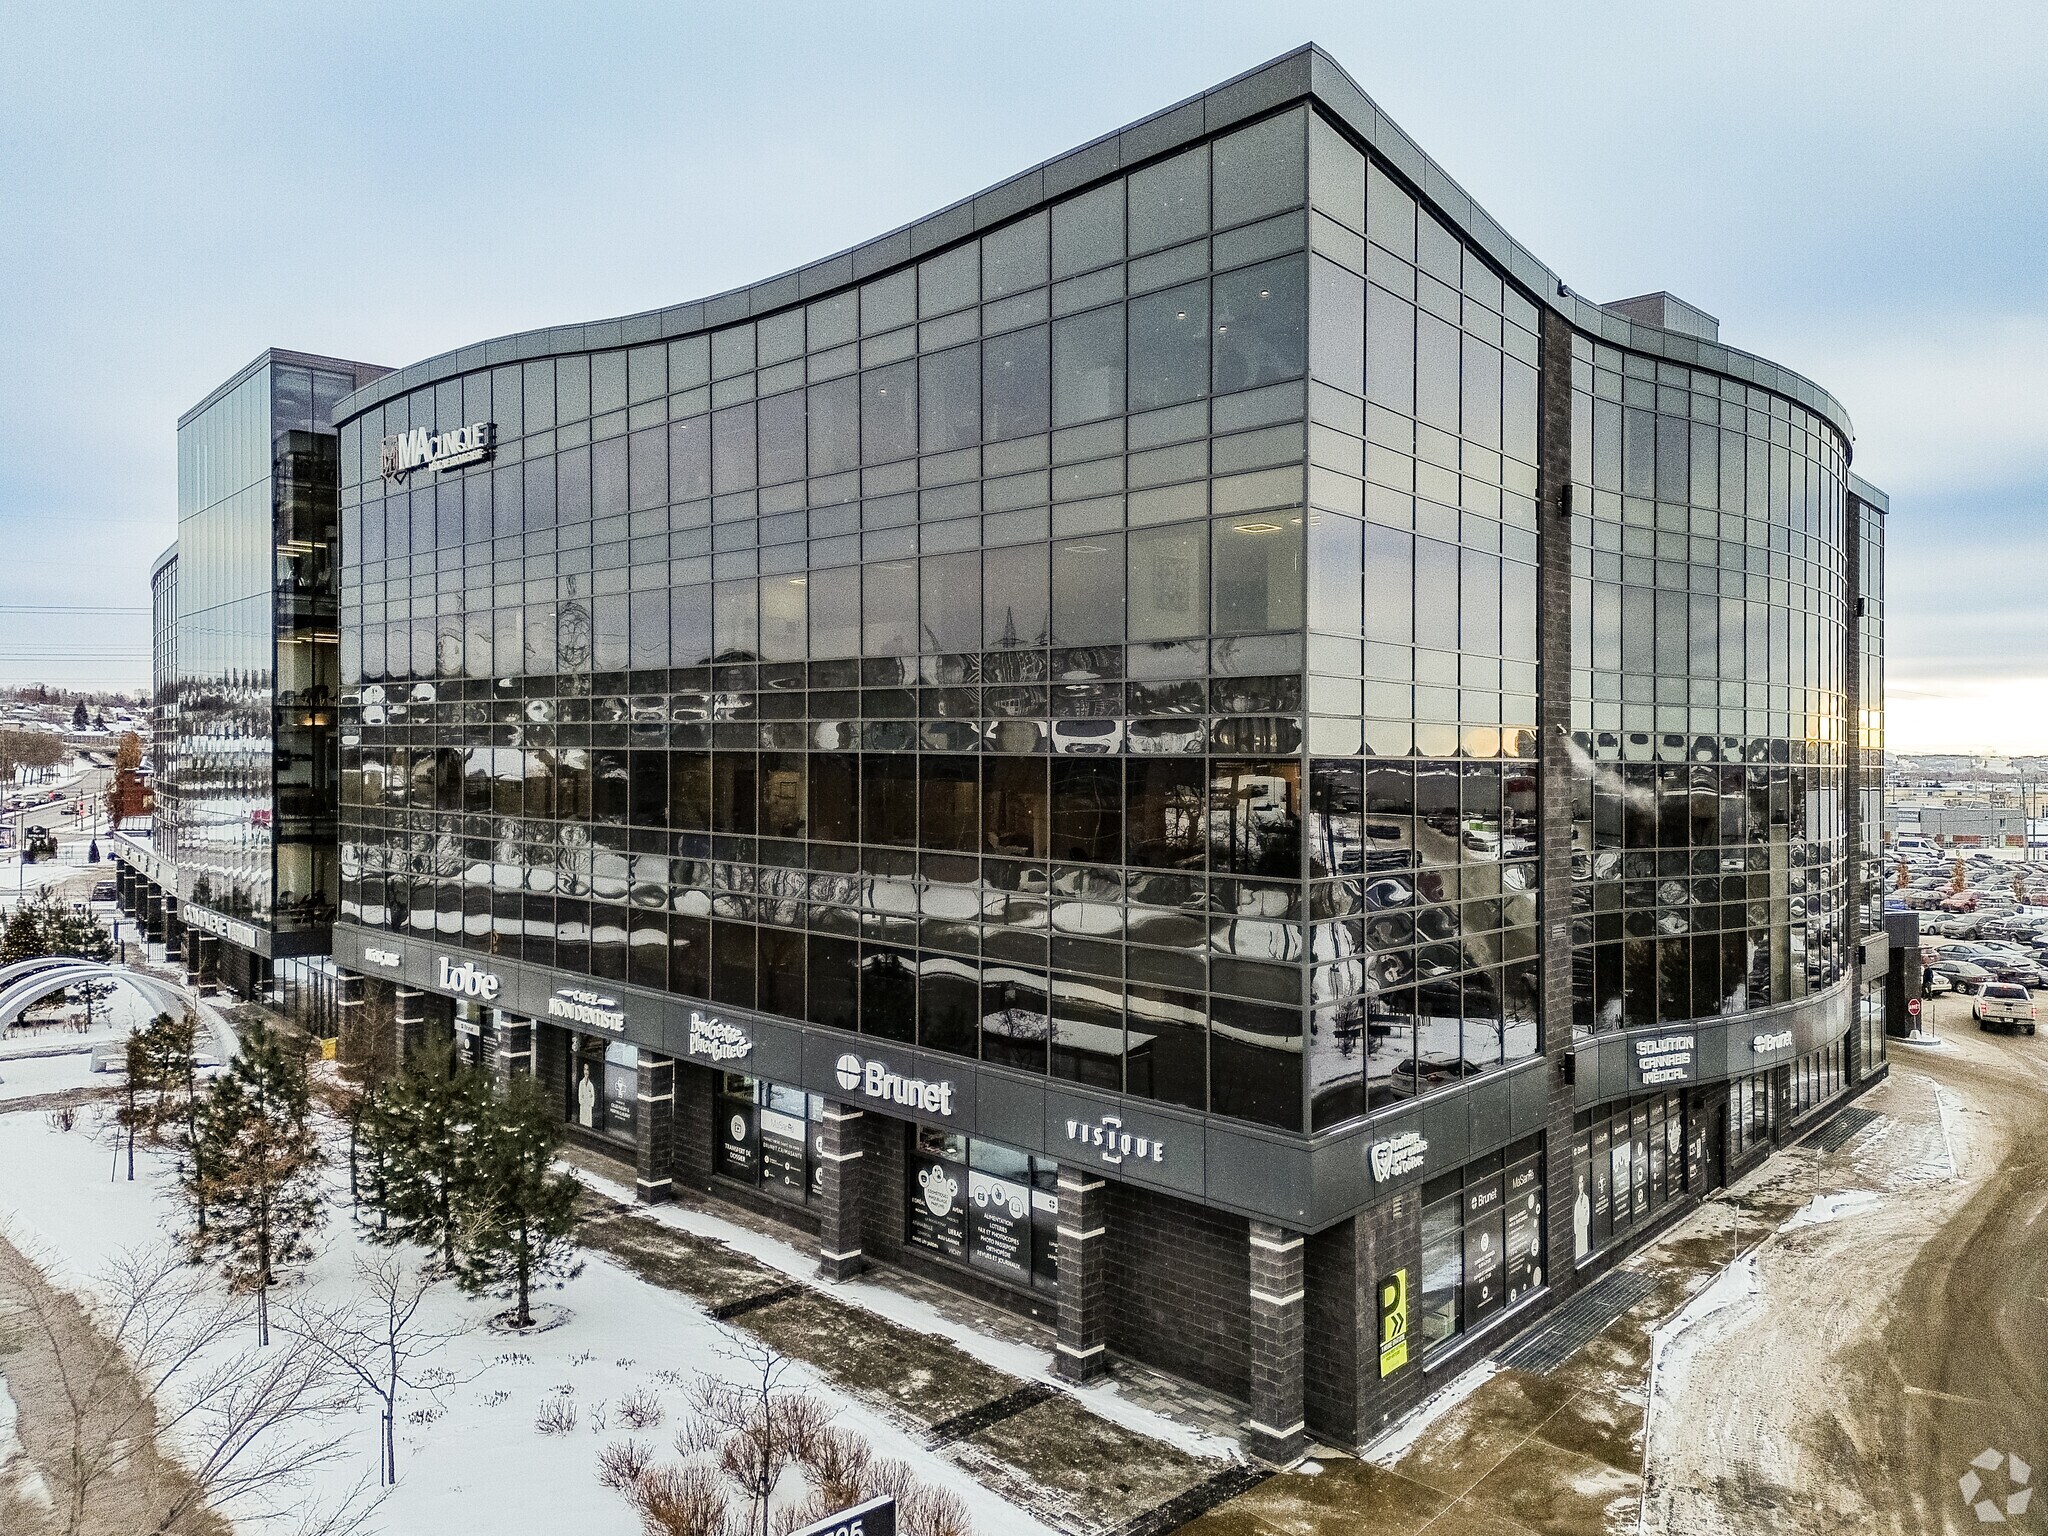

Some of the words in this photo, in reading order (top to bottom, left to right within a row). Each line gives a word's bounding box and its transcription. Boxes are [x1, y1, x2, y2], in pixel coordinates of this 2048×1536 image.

[439, 956, 498, 1000] Lobe
[1636, 1036, 1694, 1055] SOLUTION
[1767, 1030, 1793, 1051] Brunet
[1639, 1052, 1691, 1070] CANNABIS
[865, 1061, 952, 1115] Brunet
[1067, 1120, 1163, 1162] VISIQUE
[1478, 1187, 1498, 1207] Brunet
